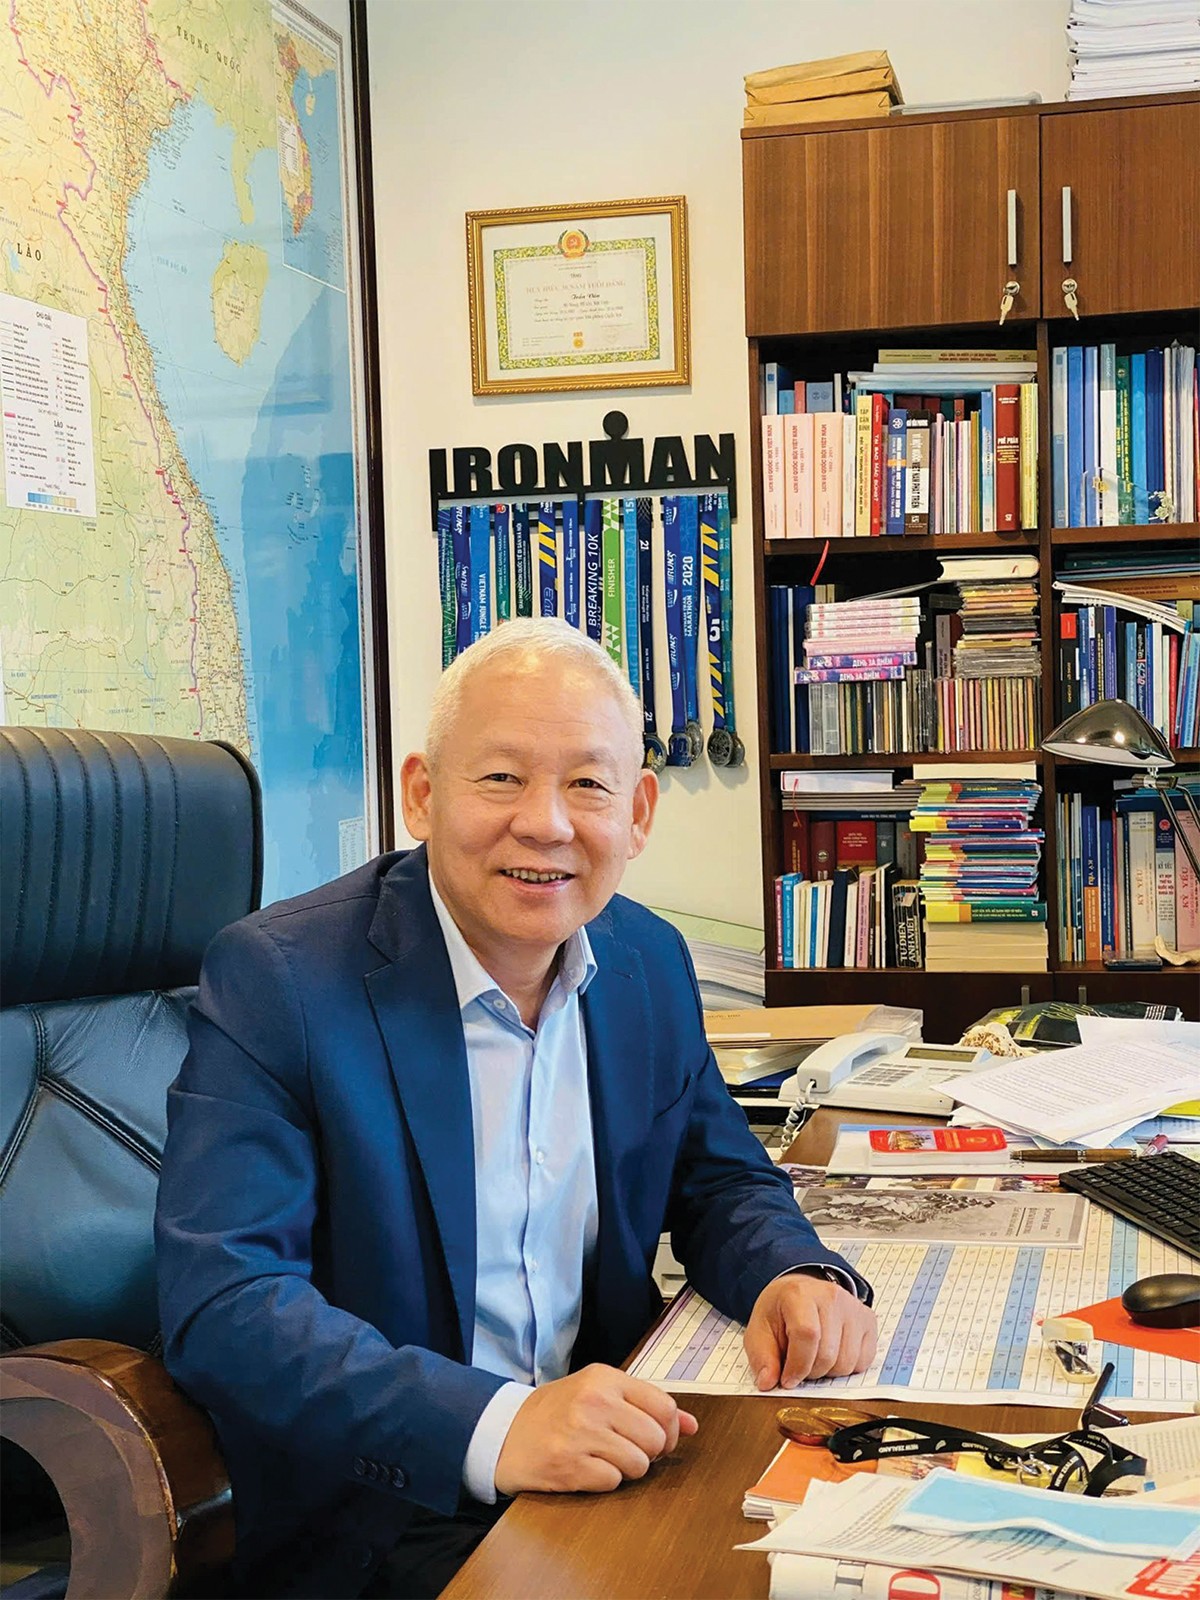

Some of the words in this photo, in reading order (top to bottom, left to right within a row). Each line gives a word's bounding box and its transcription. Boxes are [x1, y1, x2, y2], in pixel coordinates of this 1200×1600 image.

[16, 242, 42, 262] LÀO
[429, 433, 735, 494] IRONMAN
[626, 498, 634, 514] 15
[588, 534, 598, 556] 10K
[682, 556, 693, 586] 2020
[588, 562, 597, 626] BREAKING
[878, 1445, 906, 1453] ZEALAND
